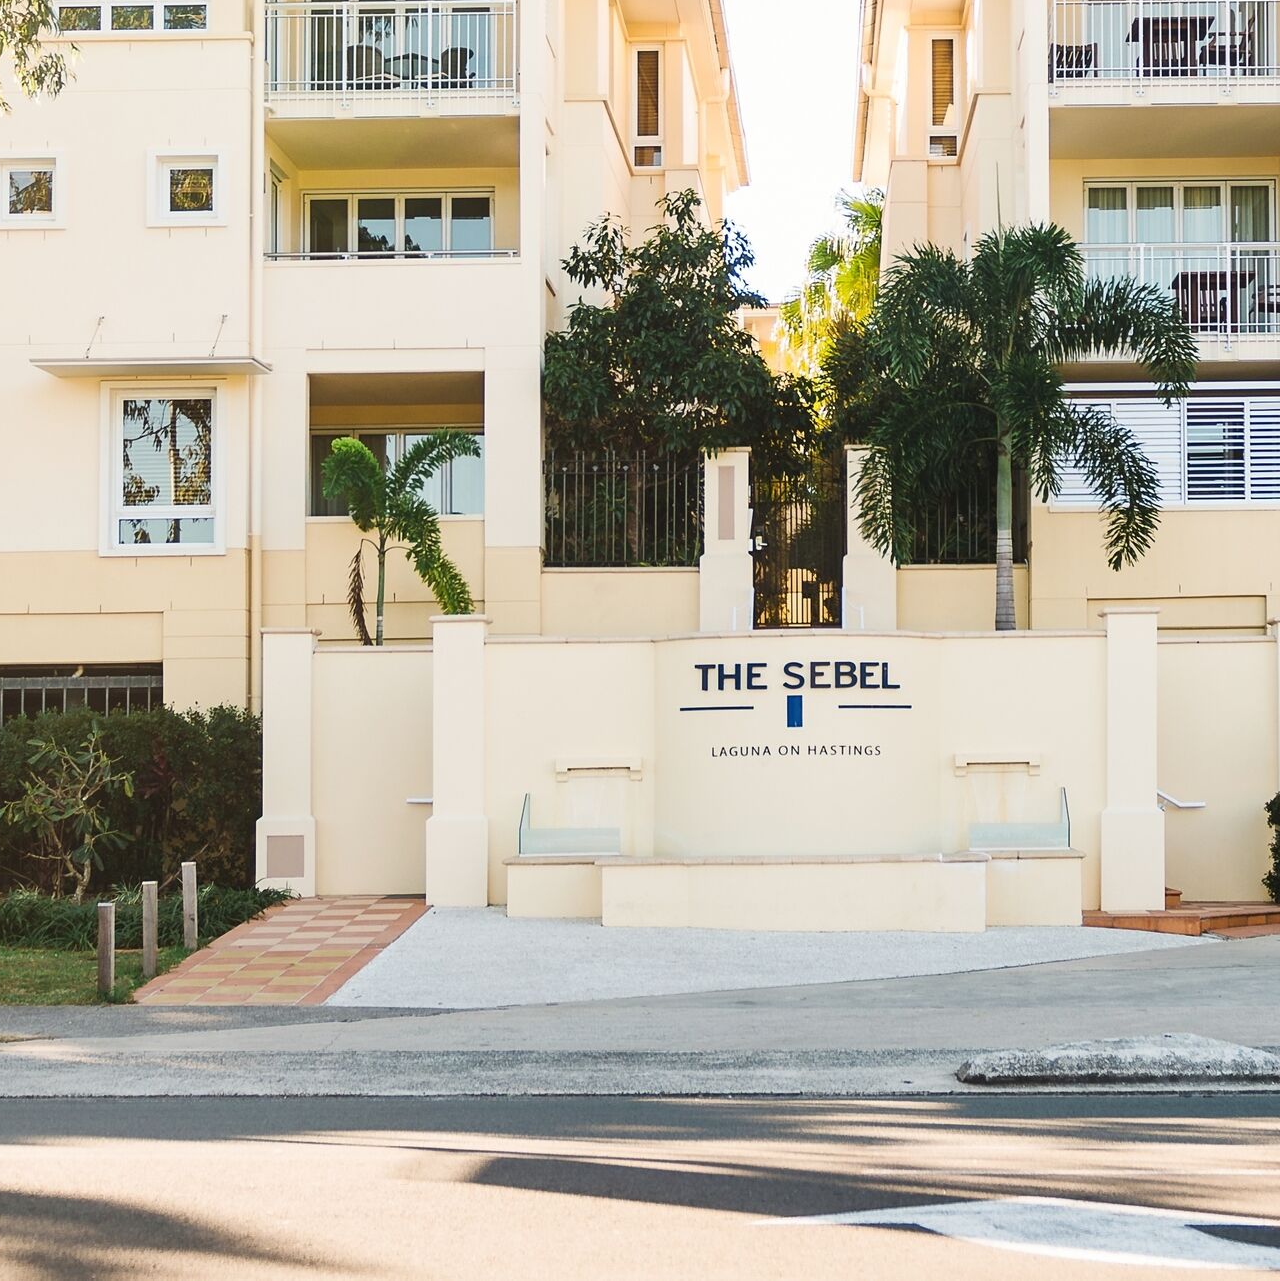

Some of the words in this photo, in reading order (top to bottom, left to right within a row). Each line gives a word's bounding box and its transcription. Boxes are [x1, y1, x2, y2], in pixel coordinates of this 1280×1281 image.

[695, 662, 768, 691] THE
[782, 661, 901, 690] SEBEL
[711, 745, 772, 757] LAGUNA
[778, 745, 800, 756] ON
[808, 745, 881, 756] HASTINGS
